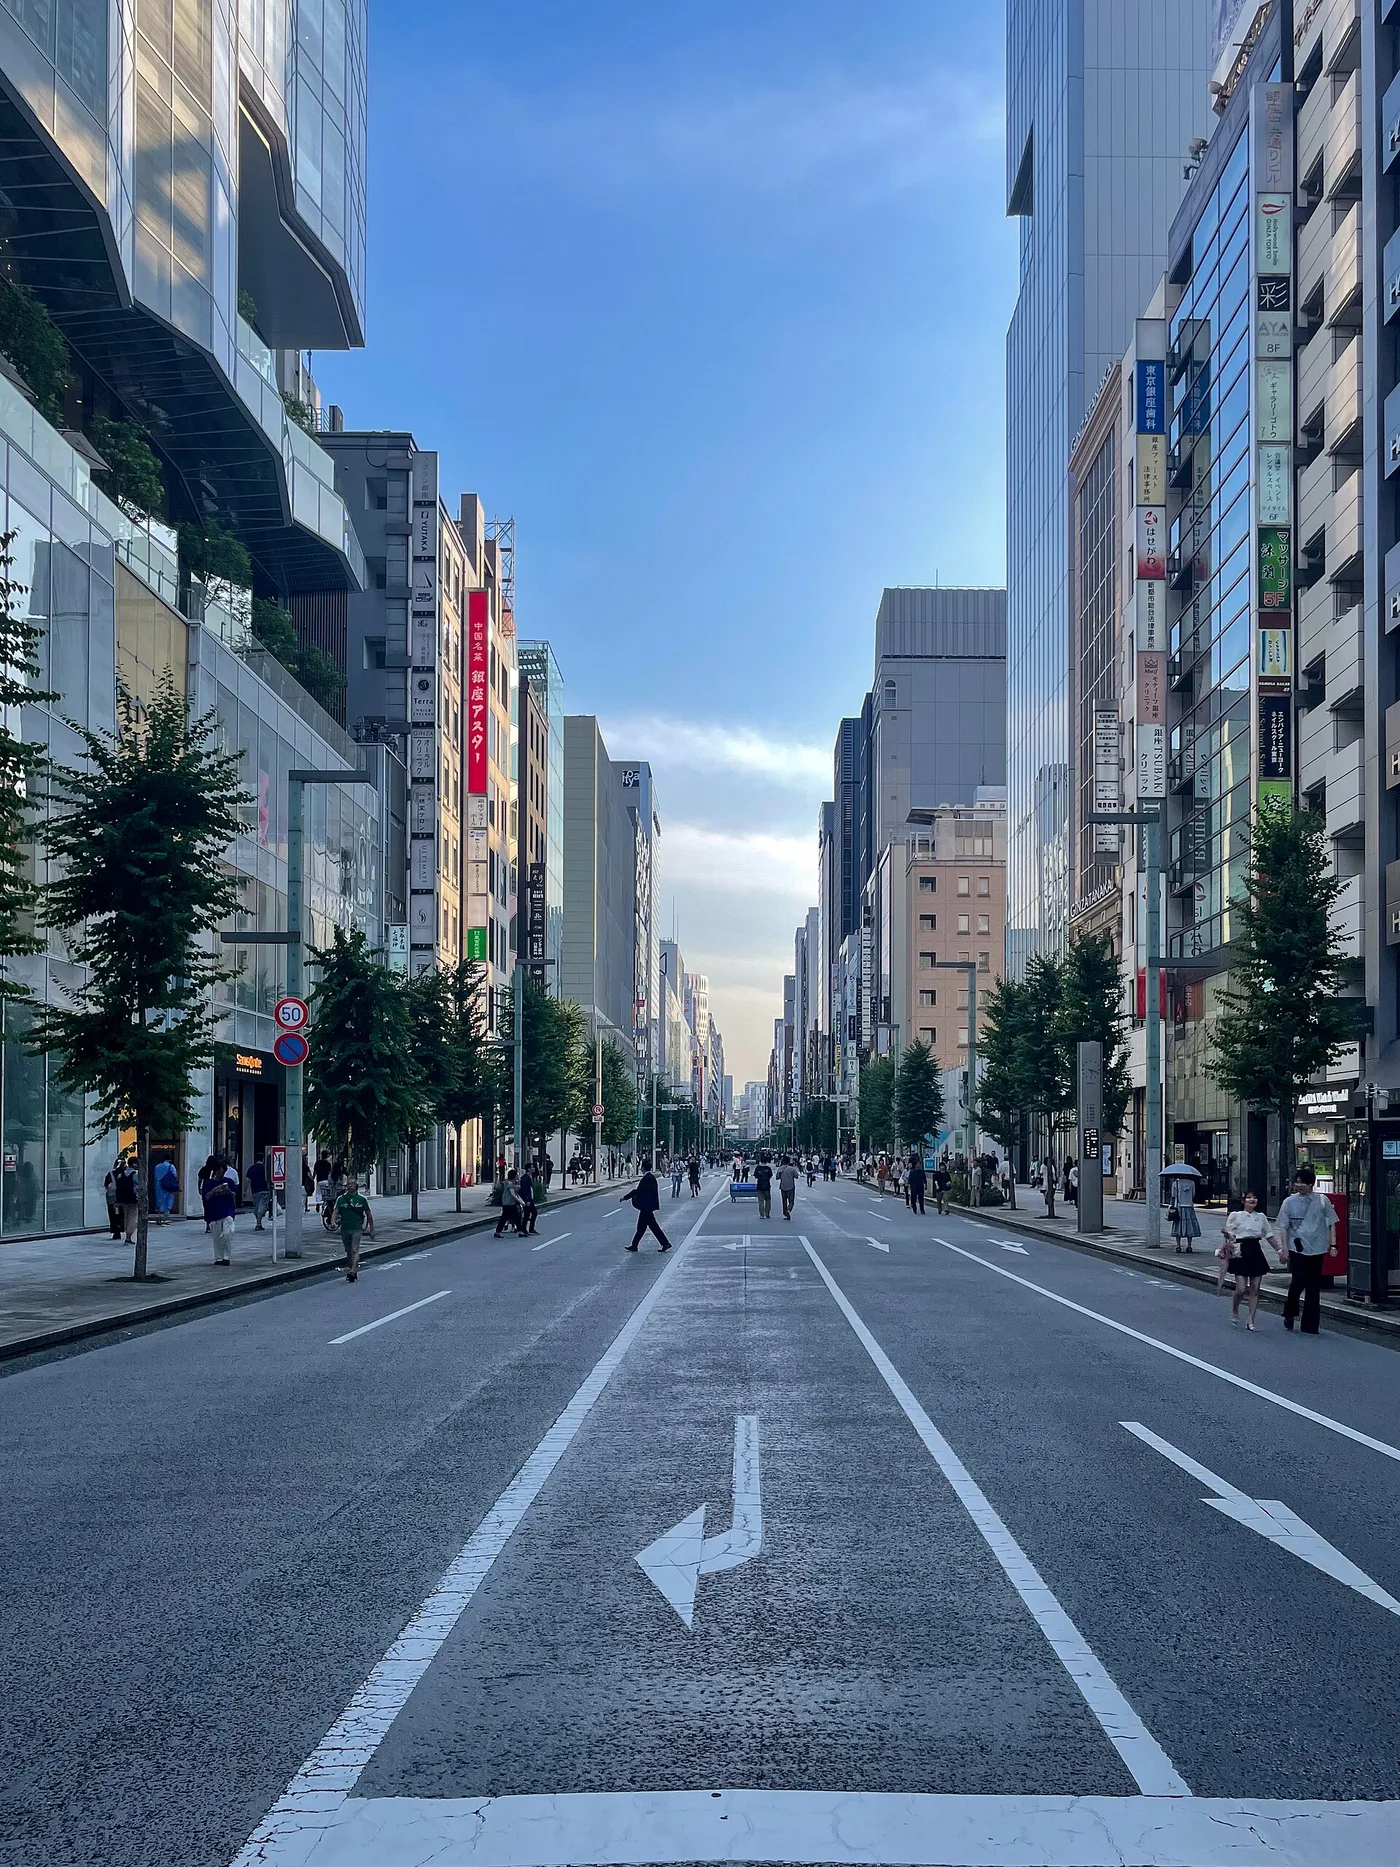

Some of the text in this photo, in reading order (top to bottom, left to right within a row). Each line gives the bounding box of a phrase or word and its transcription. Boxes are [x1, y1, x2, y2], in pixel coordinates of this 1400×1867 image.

[1260, 282, 1287, 308] 彩
[1258, 321, 1288, 332] AYA
[1266, 343, 1280, 353] 8F
[1145, 365, 1157, 430] 東京銀座歯科
[1151, 436, 1159, 489] 銀座ファースト
[1146, 528, 1156, 565] はせがわ
[1263, 591, 1285, 606] 5F
[473, 621, 483, 662] 中国名菜
[471, 670, 485, 763] 銀座アスター
[622, 770, 640, 788] itoya
[1140, 753, 1148, 793] クリニック
[282, 1007, 301, 1021] 50
